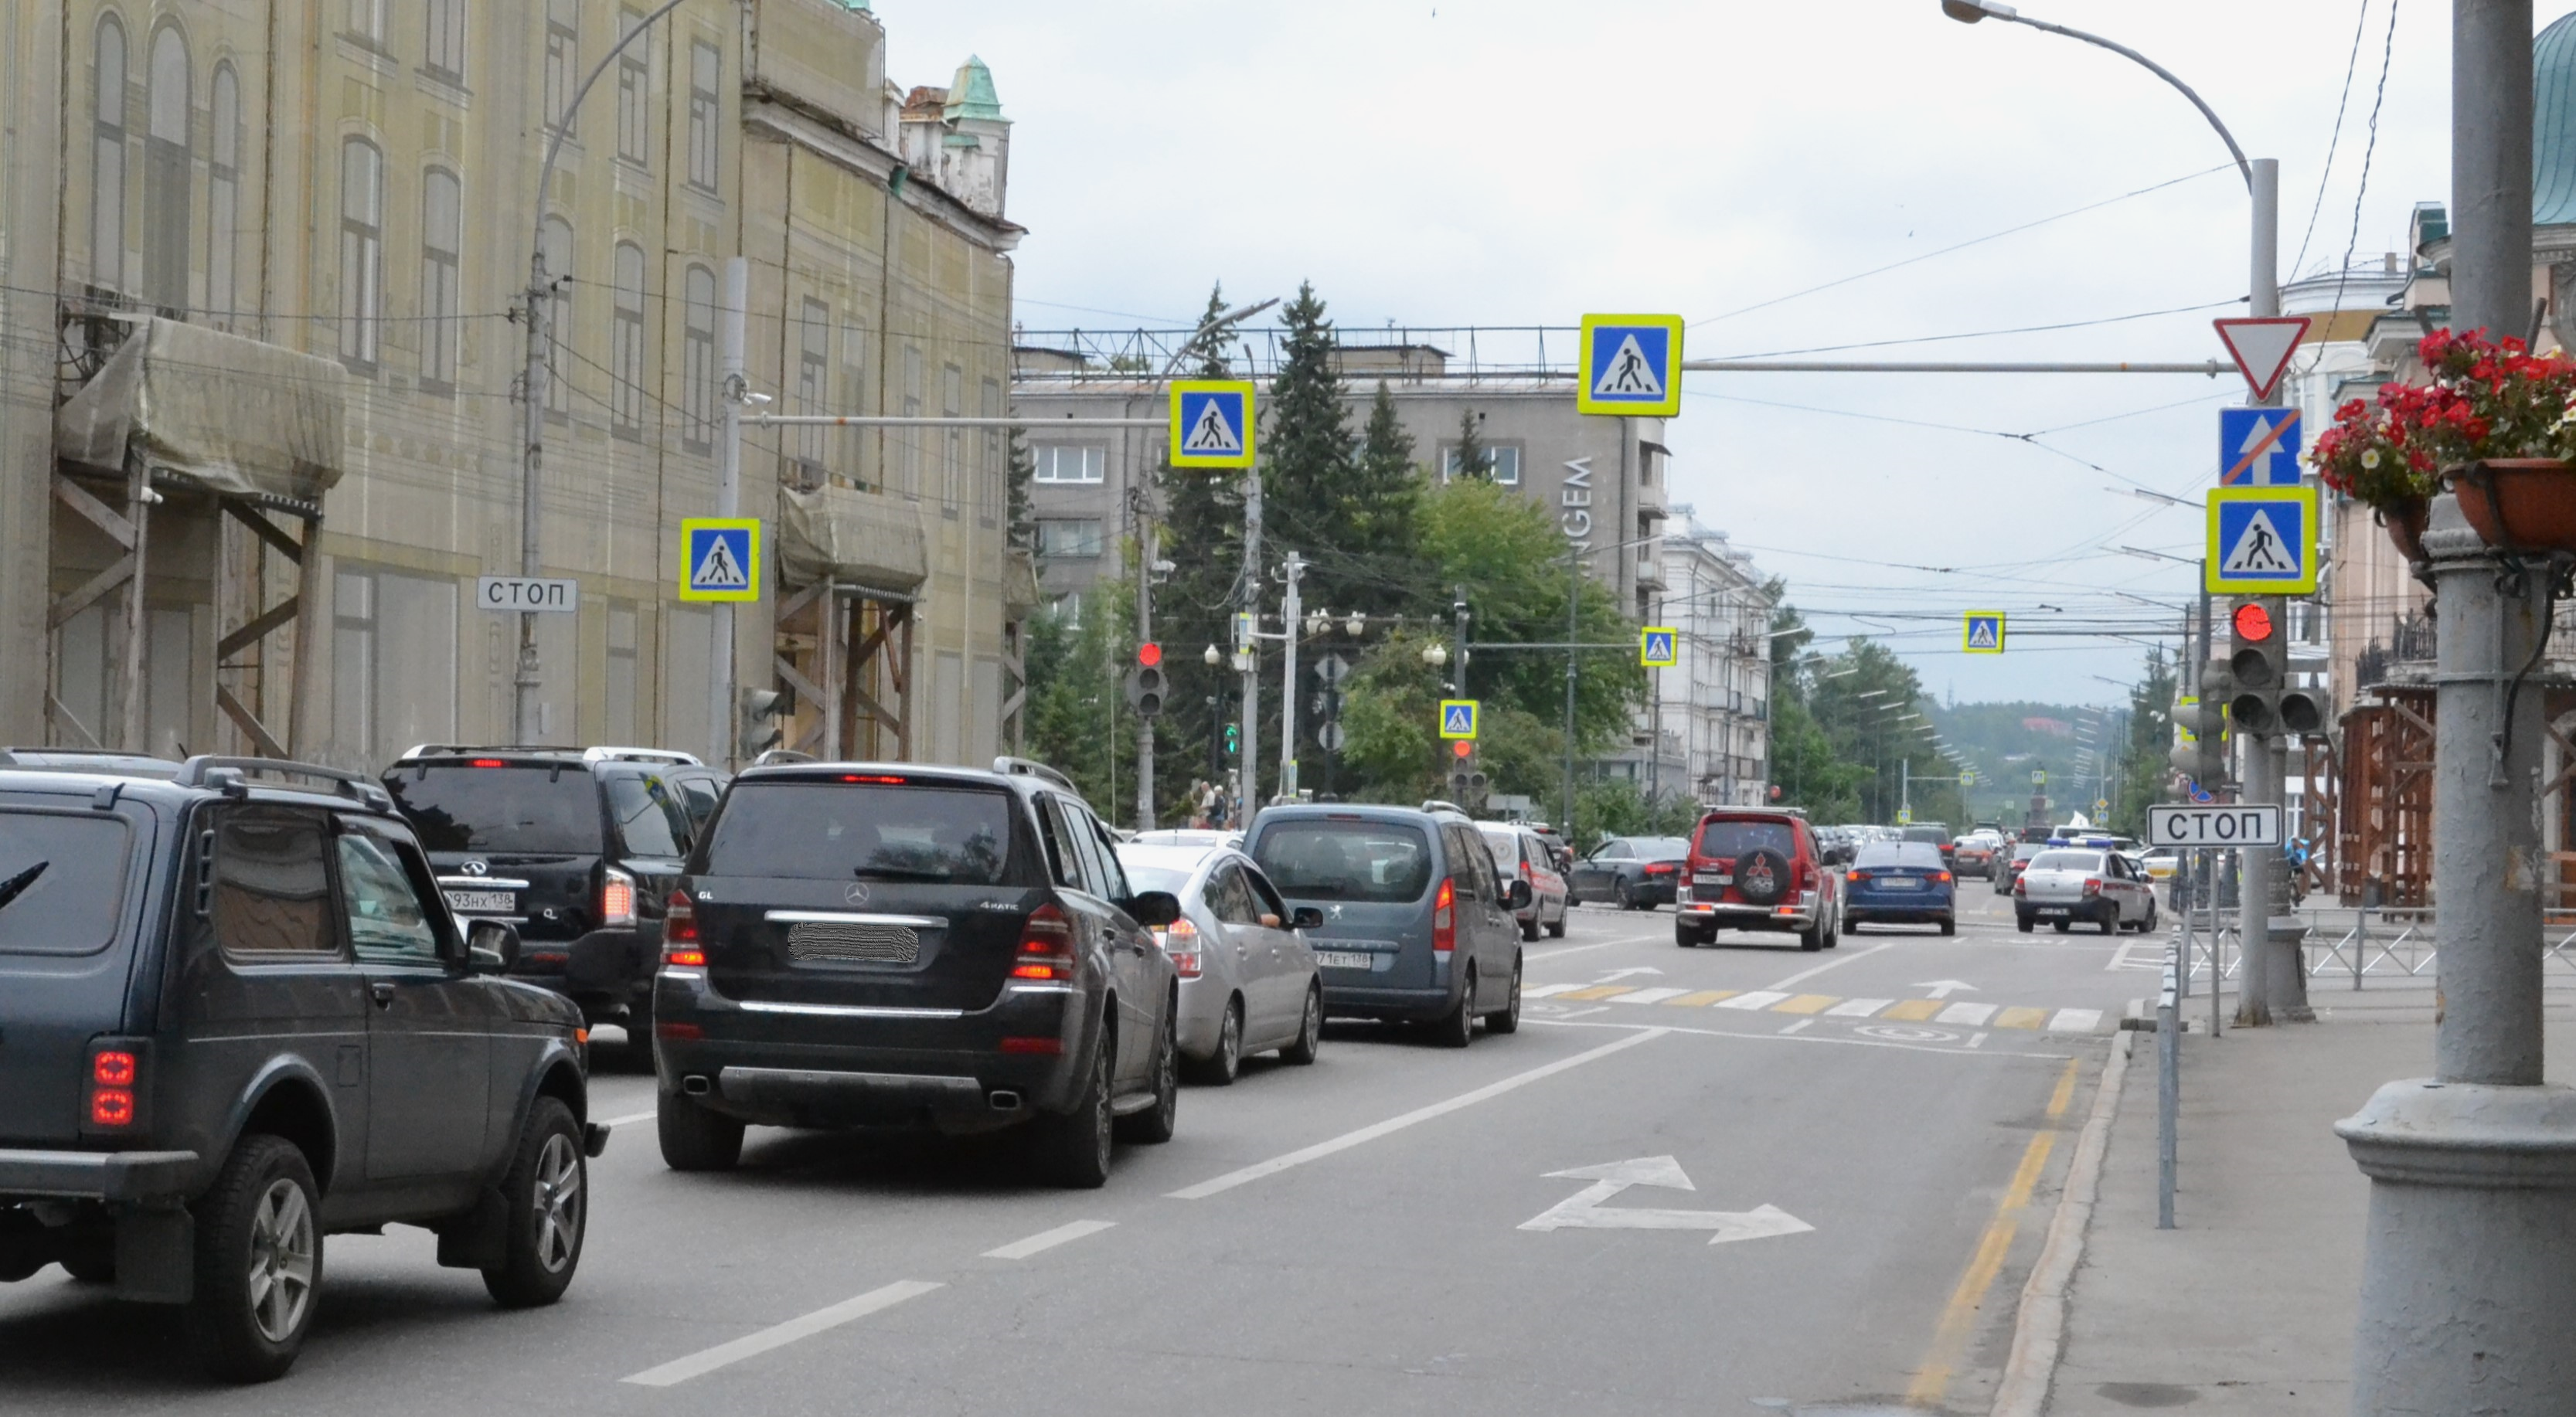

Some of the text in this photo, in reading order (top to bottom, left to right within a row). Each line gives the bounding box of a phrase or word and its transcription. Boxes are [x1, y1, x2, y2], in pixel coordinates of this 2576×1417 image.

[488, 581, 563, 605] СТОП
[2167, 813, 2261, 840] СТОП
[451, 892, 510, 908] 93НХ 138
[698, 891, 713, 900] GL
[1315, 952, 1347, 965] 71ЕТ
